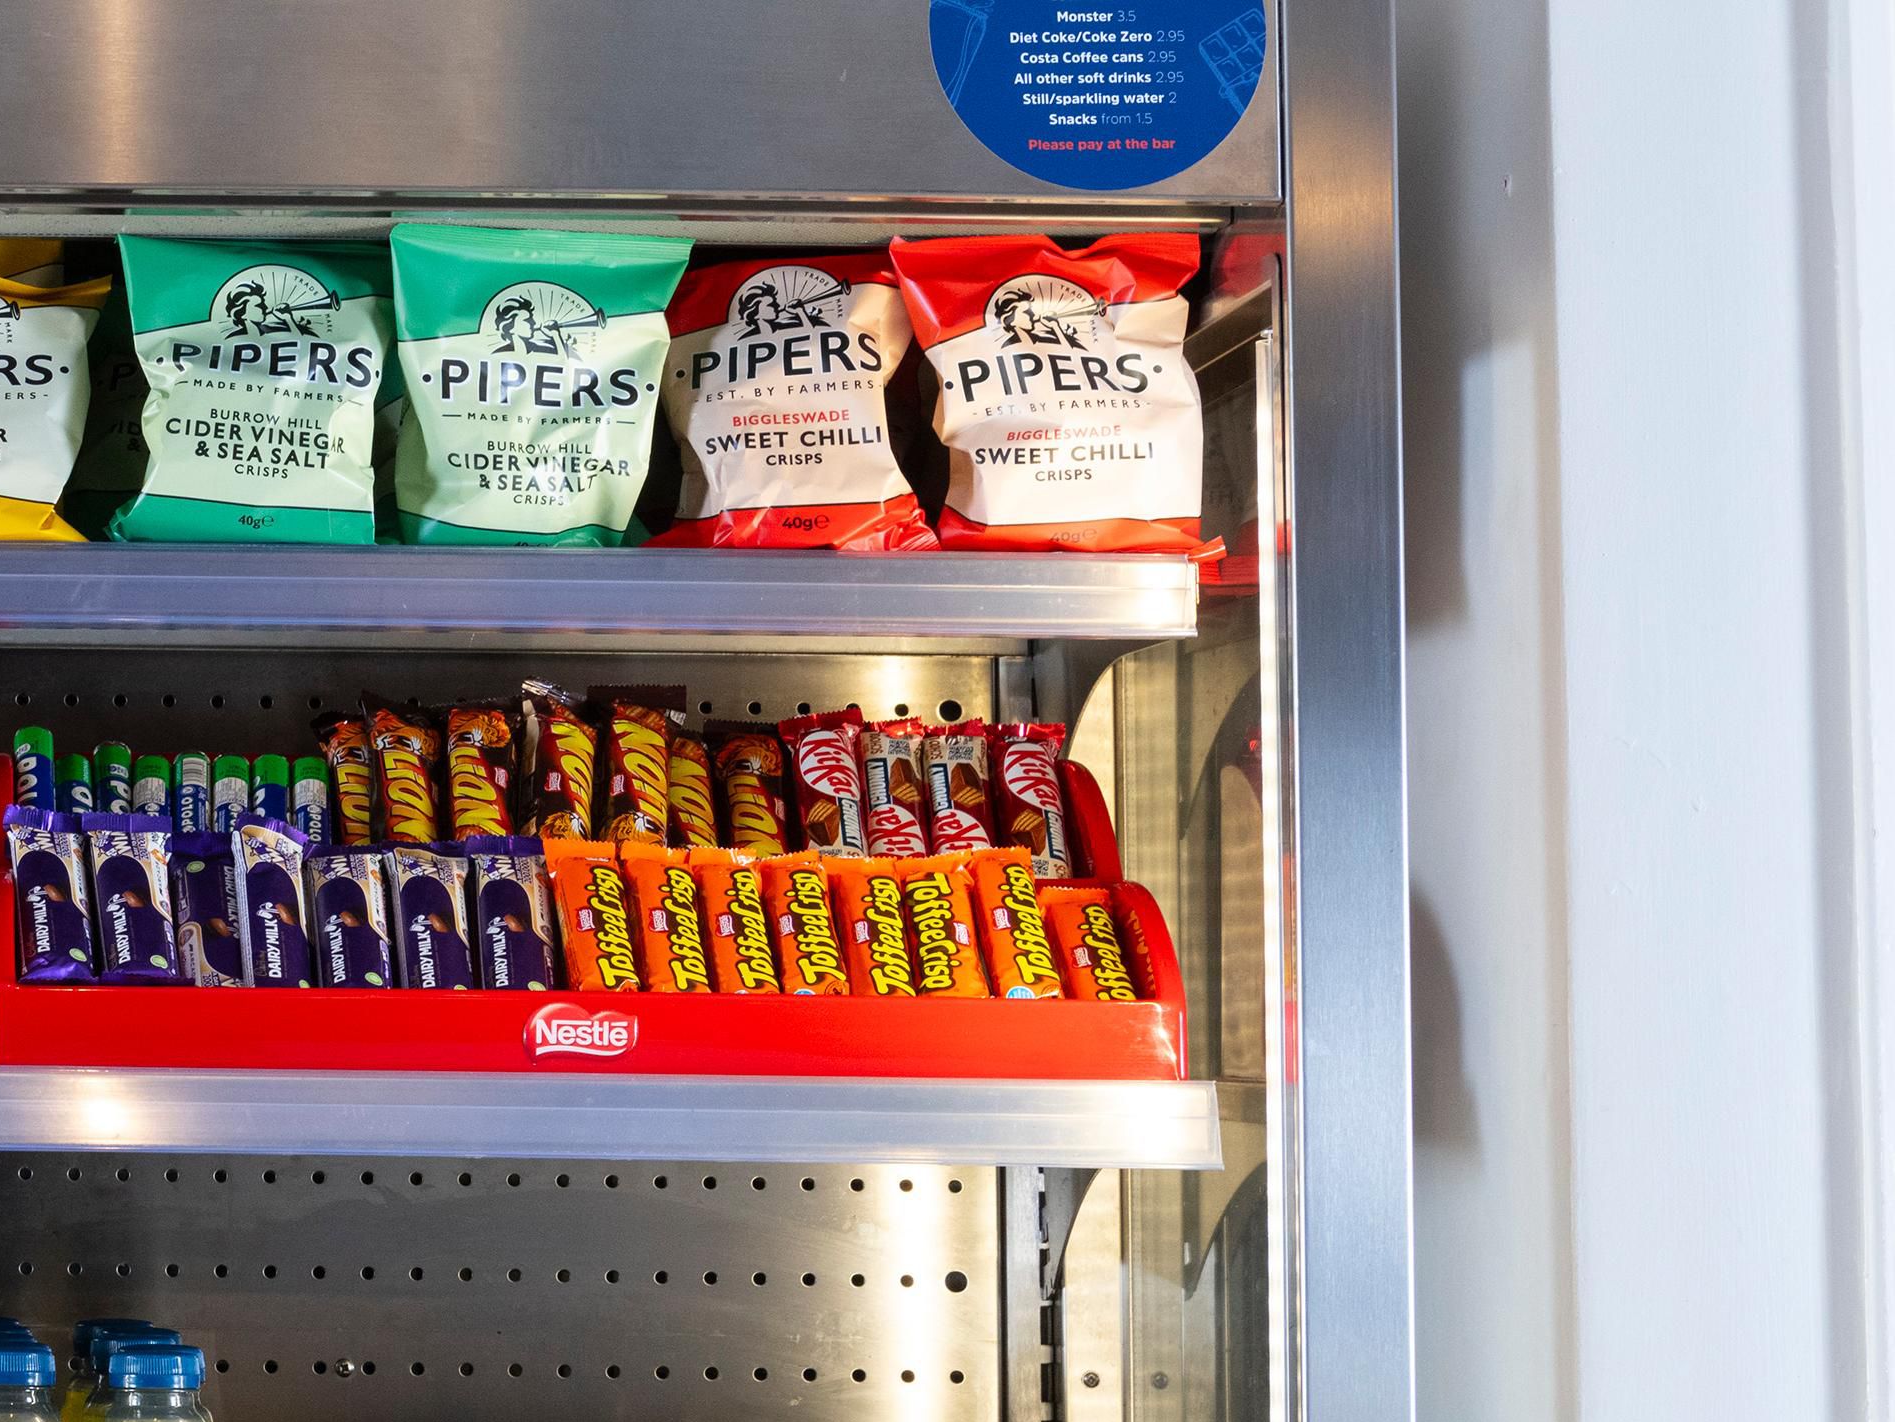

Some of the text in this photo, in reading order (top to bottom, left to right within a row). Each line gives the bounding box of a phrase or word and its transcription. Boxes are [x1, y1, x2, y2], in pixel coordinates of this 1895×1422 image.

[1056, 10, 1137, 23] Monster 3.5
[1009, 30, 1185, 44] Diet Coke/Coke Zero 2.95
[1020, 51, 1177, 65] Costa Coffee cans 2.95
[1013, 71, 1185, 85] All other soft drinks 2.95
[1022, 91, 1177, 107] Still/sparkling water 2
[1049, 112, 1153, 126] Snacks from 1.5
[1028, 137, 1176, 153] Please pay at the bar
[173, 341, 373, 386] PIPERS
[691, 331, 883, 390] PIPERS
[441, 359, 640, 408] PIPERS
[958, 352, 1151, 403] PIPERS
[209, 407, 322, 430] BURROW HILL
[732, 409, 851, 428] BIGGLESWADE
[164, 417, 346, 456] CIDER VINEGAR
[705, 426, 883, 456] SWEET CHILLI
[1006, 424, 1123, 442] BIGGLESWADE
[194, 441, 330, 470] & SEA SALT
[765, 452, 824, 467] CRISPS
[974, 441, 1154, 466] SWEET CHILLI
[234, 463, 289, 479] CRISPS
[1035, 468, 1093, 482] CRISPS
[802, 736, 859, 798] KitKat
[34, 901, 50, 953] DAIRY MILK
